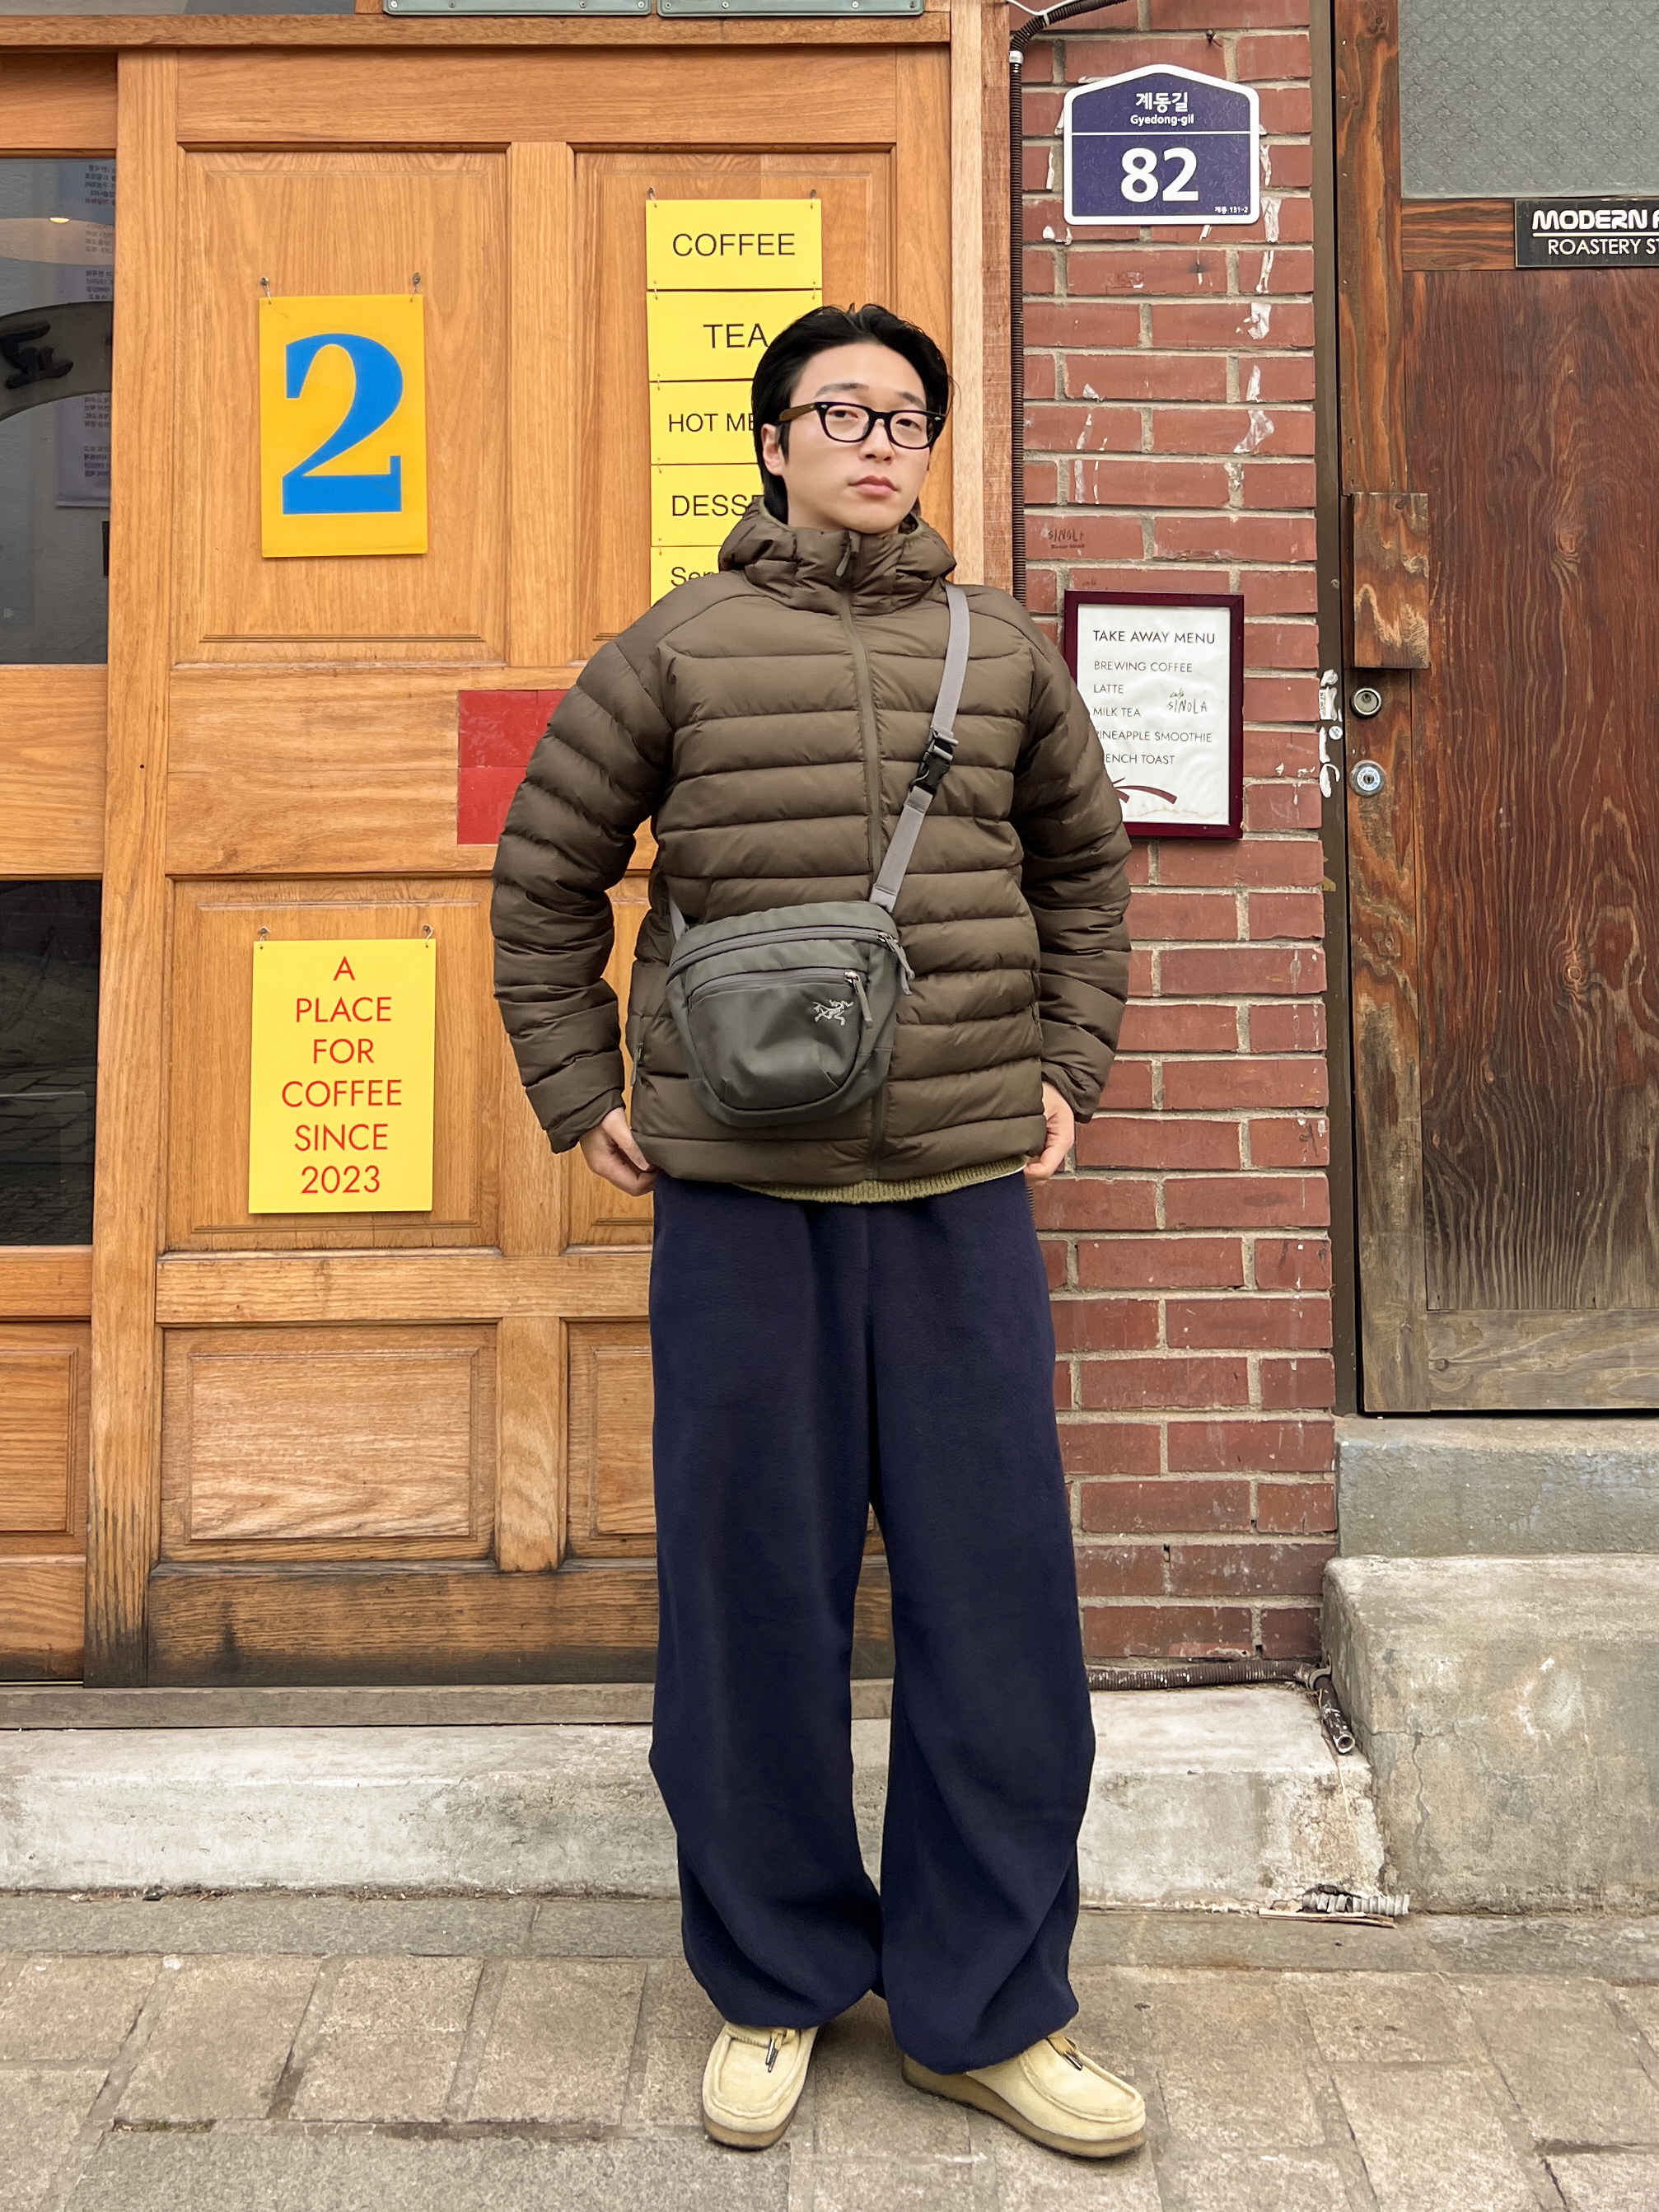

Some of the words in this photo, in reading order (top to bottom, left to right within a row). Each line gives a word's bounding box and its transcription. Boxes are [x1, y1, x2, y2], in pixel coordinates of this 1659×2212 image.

[1136, 92, 1188, 113] 계동길
[1130, 114, 1194, 126] Gyedong-gil
[1121, 147, 1199, 203] 82
[1532, 209, 1647, 230] MODERN
[673, 233, 795, 256] COFFEE
[1548, 238, 1642, 255] ROASTERY
[703, 323, 769, 348] TEA
[283, 333, 404, 514] 2
[669, 414, 718, 432] HOT
[672, 494, 764, 516] DESS
[1093, 630, 1125, 642] TAKE
[1130, 632, 1170, 643] AWAY
[1175, 633, 1215, 644] MENU
[1094, 661, 1147, 671] BREWING
[1150, 662, 1193, 672] COFFEE
[1093, 684, 1124, 694] LATTE
[1092, 708, 1118, 717] MILK
[1121, 708, 1142, 717] TEA
[1167, 699, 1208, 714] SINOLA
[1154, 732, 1213, 742] SMOOTHIE
[1105, 753, 1138, 764] ENCH
[1141, 754, 1175, 765] TOAST
[333, 956, 356, 981] A
[297, 997, 392, 1022] PLACE
[313, 1038, 375, 1064] FOR
[282, 1079, 402, 1107] COFFEE
[294, 1123, 388, 1152] SINCE
[300, 1165, 381, 1194] 2023
